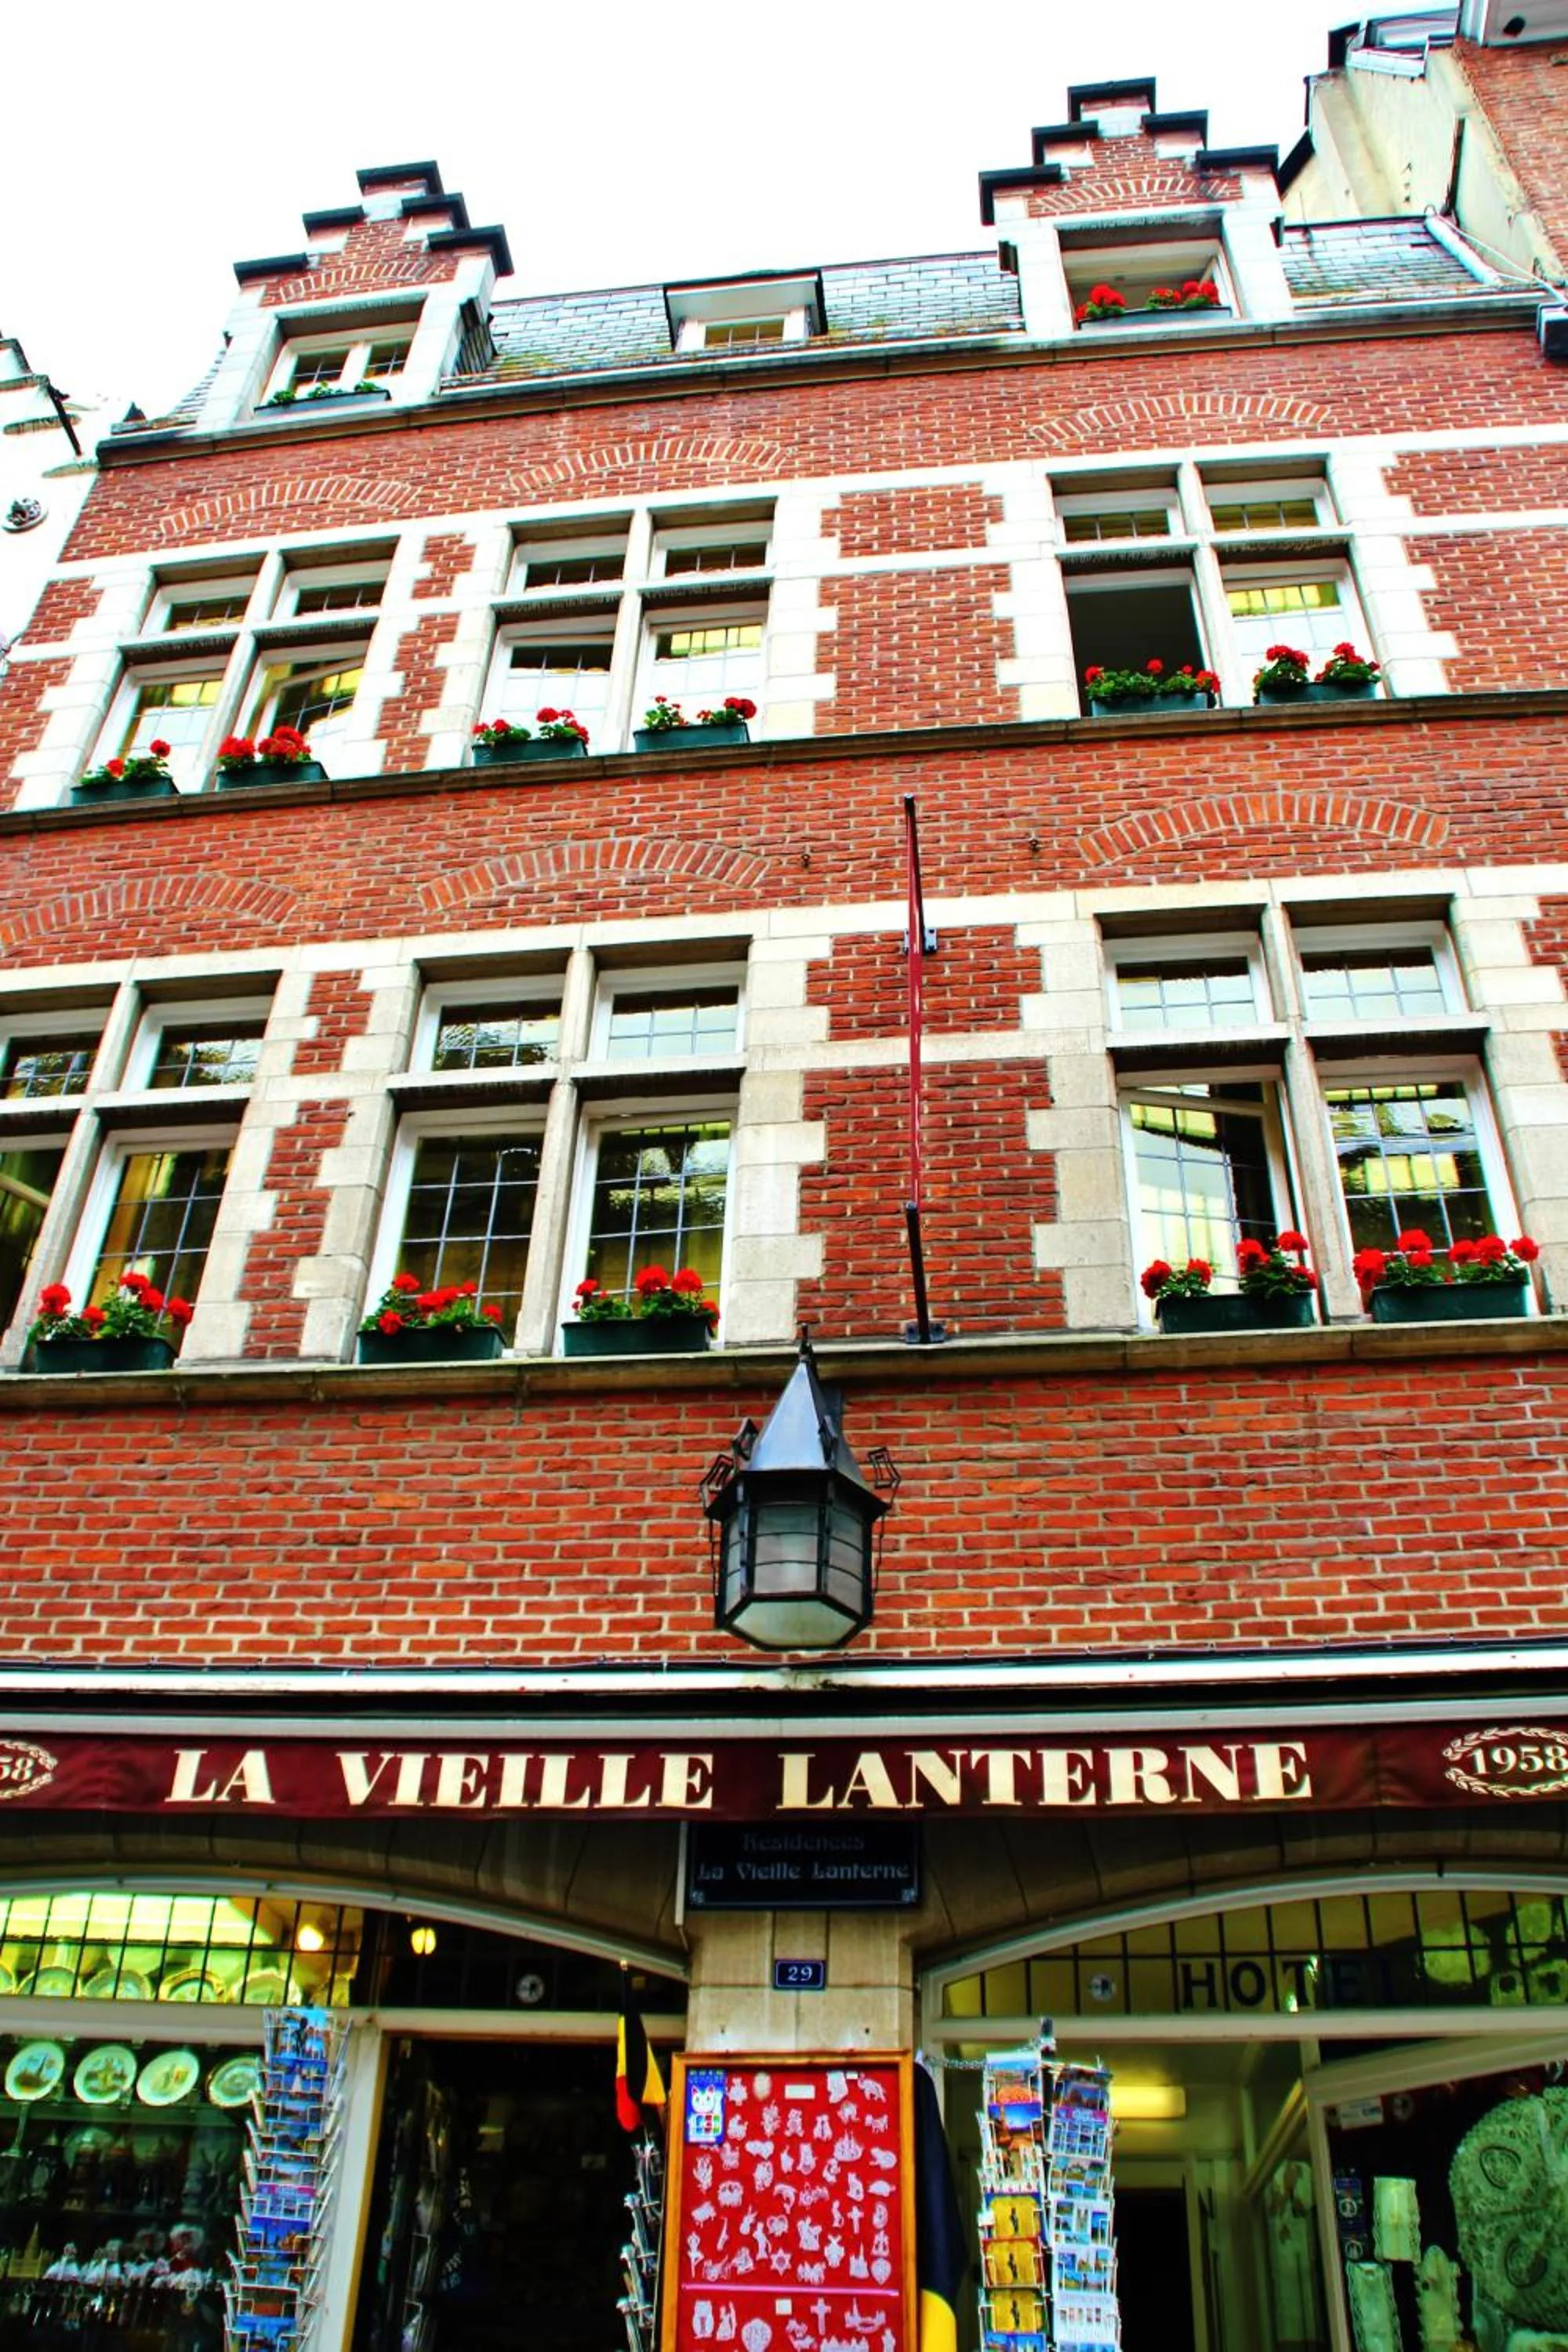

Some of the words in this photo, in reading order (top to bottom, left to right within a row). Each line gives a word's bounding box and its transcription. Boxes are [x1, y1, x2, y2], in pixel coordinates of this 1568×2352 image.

[1468, 1745, 1568, 1774] 1958
[164, 1749, 276, 1804] LA
[336, 1751, 714, 1809] VIEILLE
[775, 1742, 1312, 1809] LANTERNE
[697, 1862, 724, 1881] La
[735, 1861, 803, 1880] Vieille
[811, 1861, 911, 1880] Lanterne
[787, 1965, 812, 1981] 29
